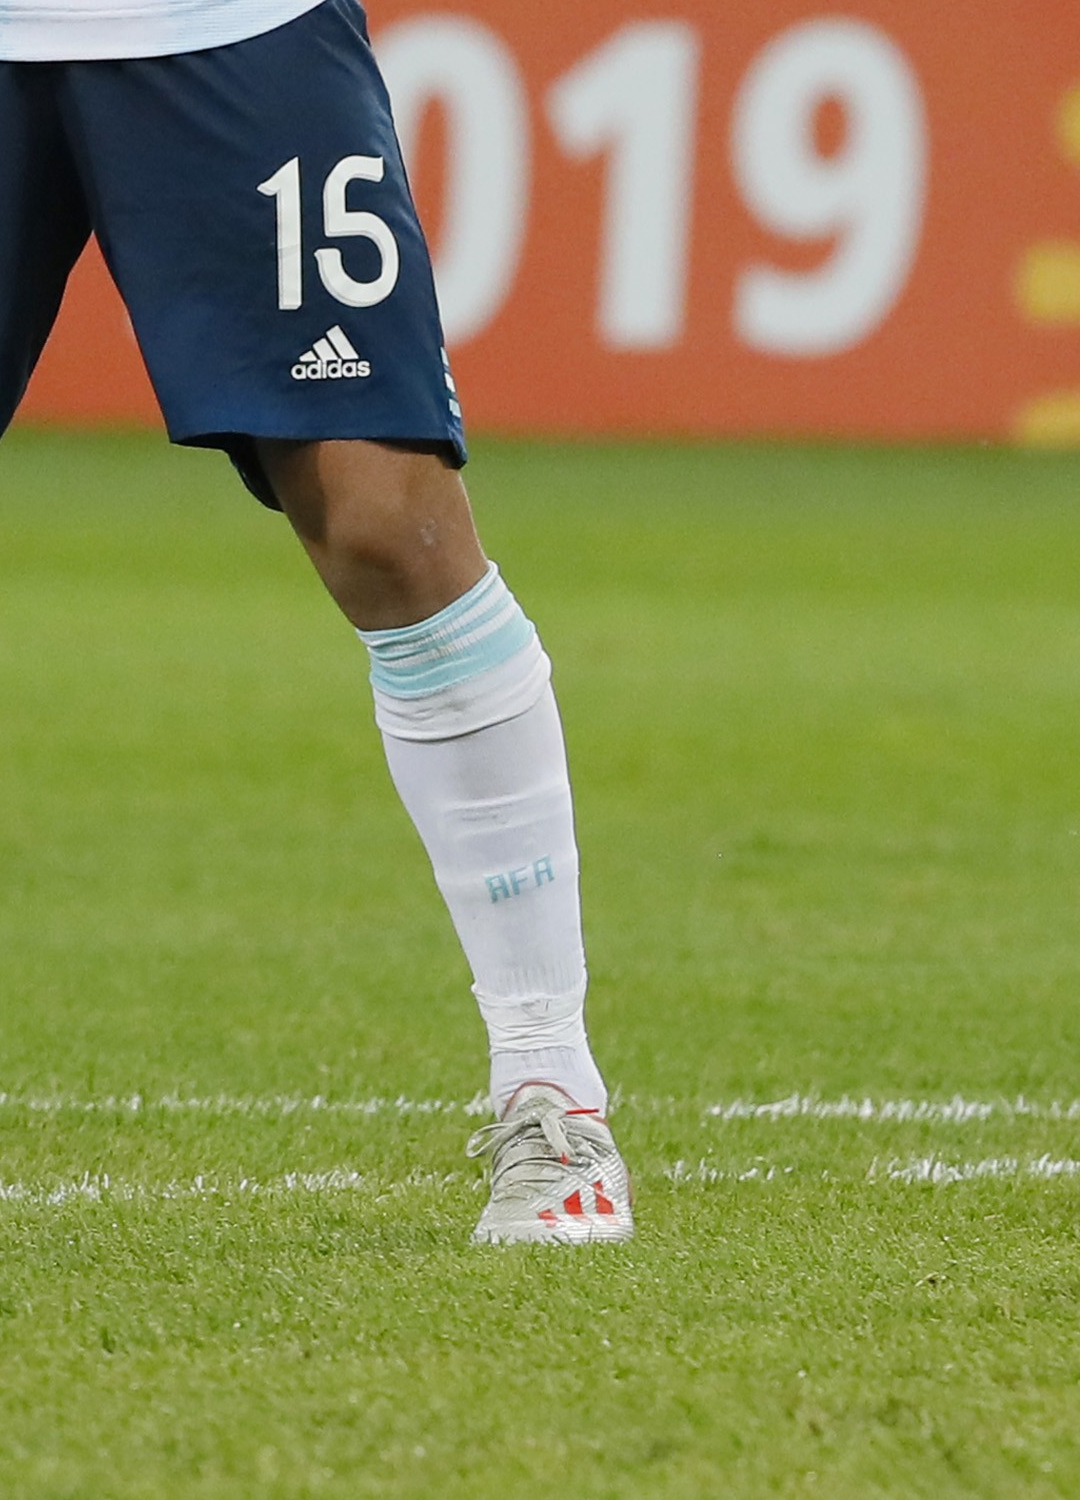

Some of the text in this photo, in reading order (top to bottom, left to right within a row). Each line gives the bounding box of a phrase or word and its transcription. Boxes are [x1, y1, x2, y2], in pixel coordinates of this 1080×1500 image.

[257, 155, 400, 310] 15
[291, 359, 370, 380] adidas
[485, 854, 555, 904] AFA
